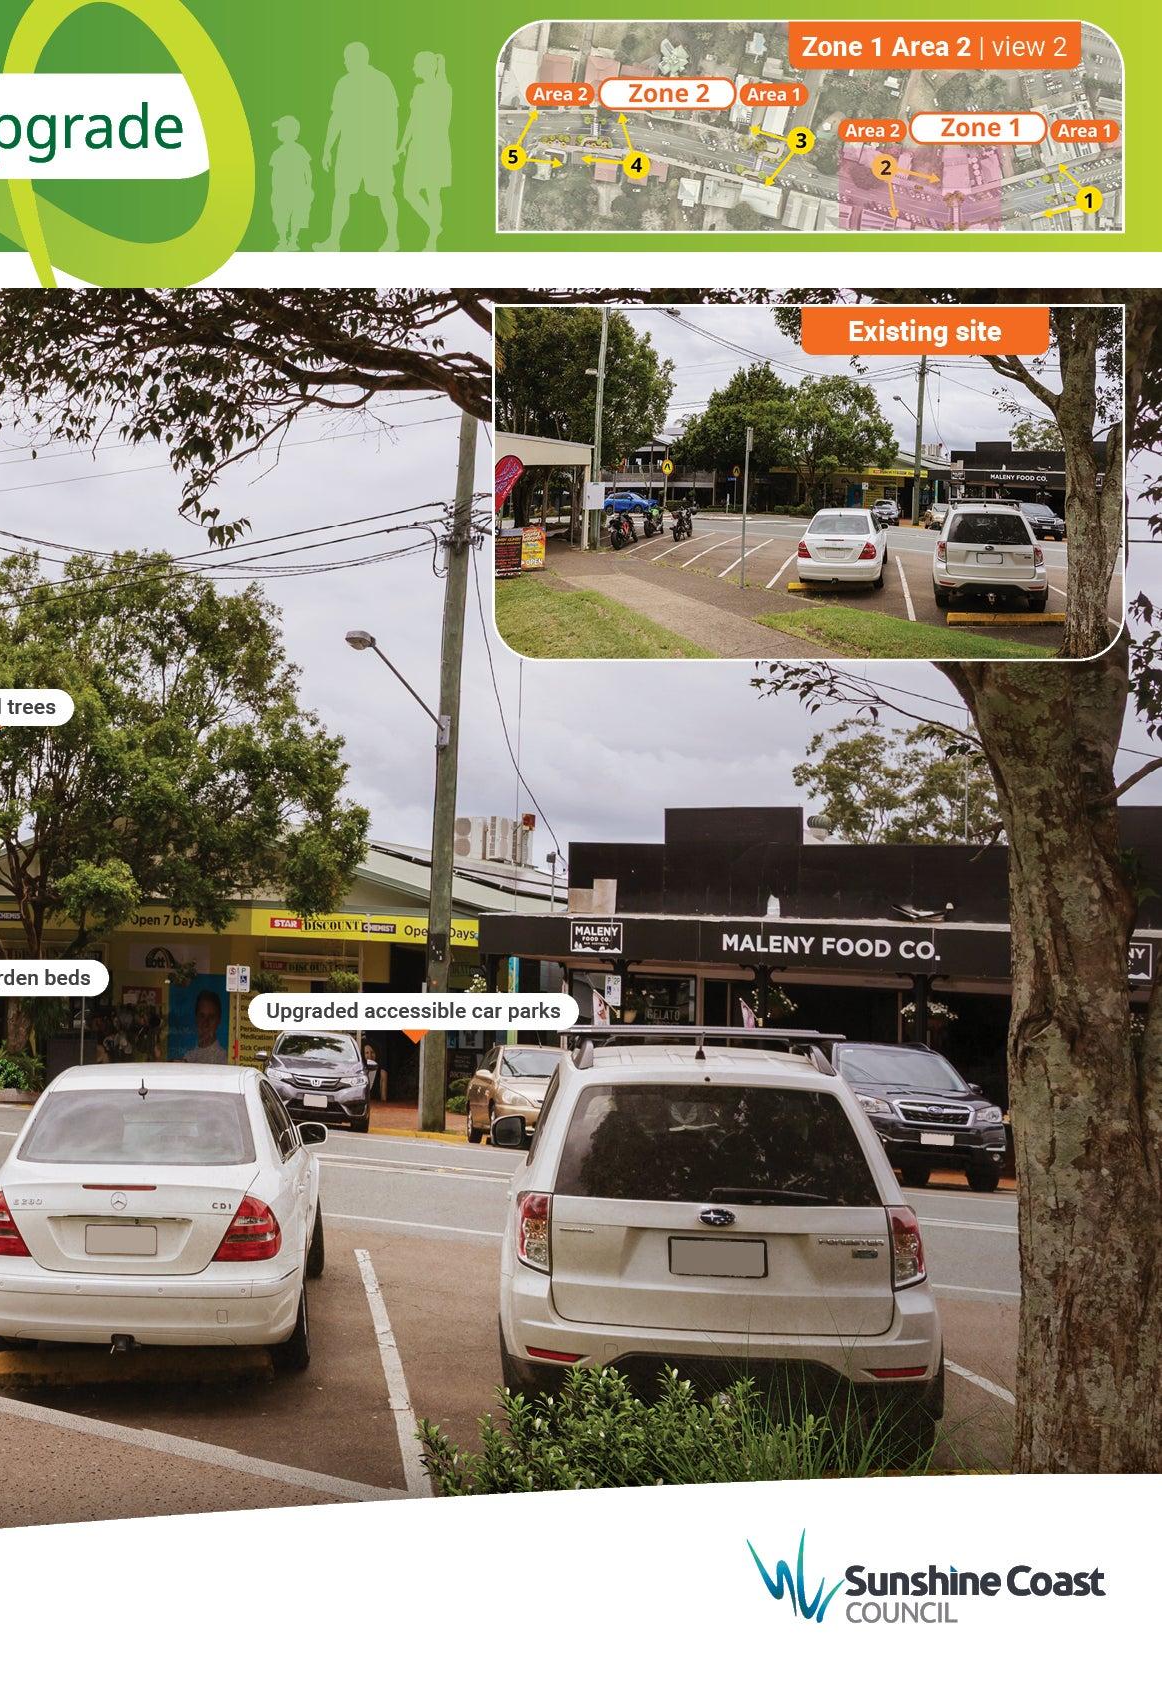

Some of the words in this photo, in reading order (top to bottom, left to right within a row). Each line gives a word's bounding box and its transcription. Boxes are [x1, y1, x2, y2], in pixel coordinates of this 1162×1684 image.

[163, 915, 171, 926] 7
[274, 919, 297, 928] STAR
[304, 920, 360, 931] DISCOUNT
[404, 924, 429, 938] Ope
[575, 926, 619, 937] MALENY
[723, 933, 815, 954] MALENY
[822, 938, 892, 958] FOOD
[898, 940, 941, 961] CO.
[211, 1202, 233, 1210] CDI
